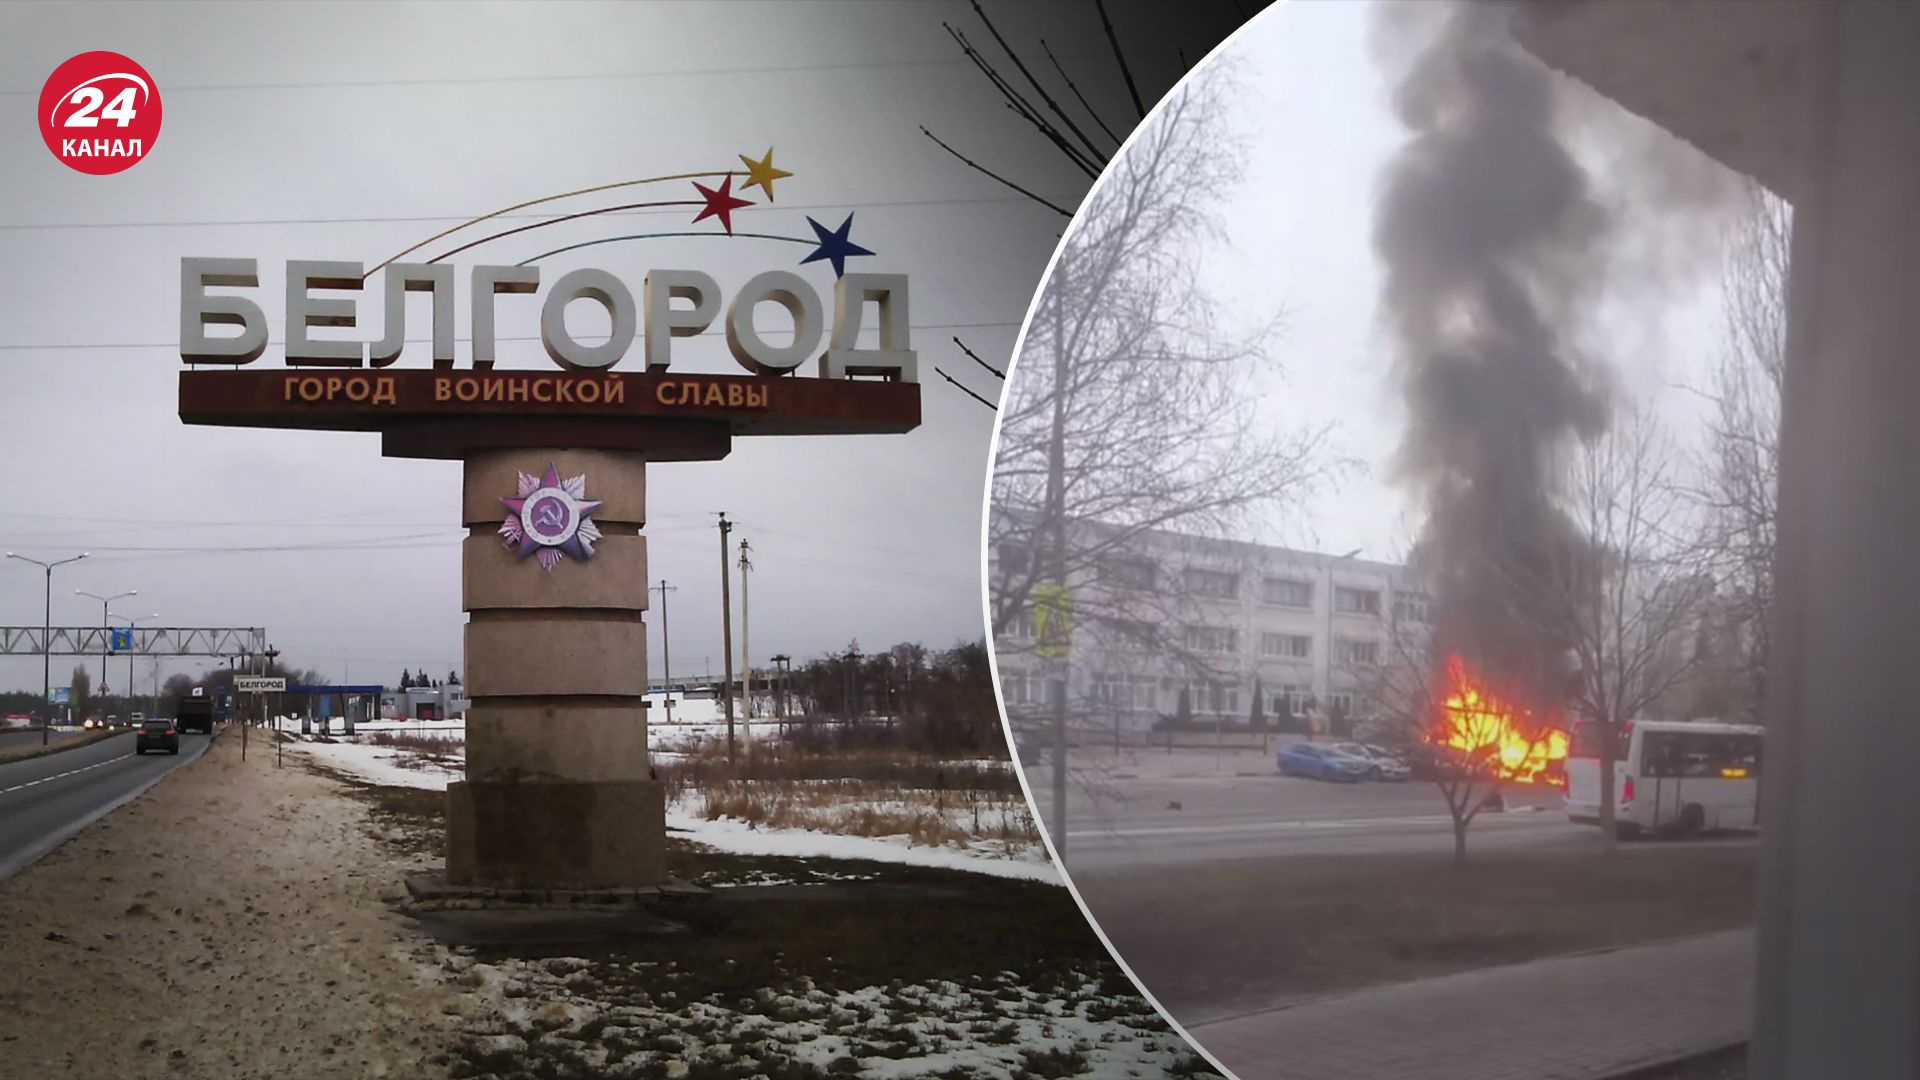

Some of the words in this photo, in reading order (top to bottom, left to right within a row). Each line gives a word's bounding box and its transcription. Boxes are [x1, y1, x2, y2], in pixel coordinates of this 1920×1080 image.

[180, 257, 919, 382] БЕЛГОРОД
[284, 377, 397, 404] ГОРОД
[435, 374, 625, 404] ВОИНСКОЙ
[656, 380, 768, 408] СЛАВЫ
